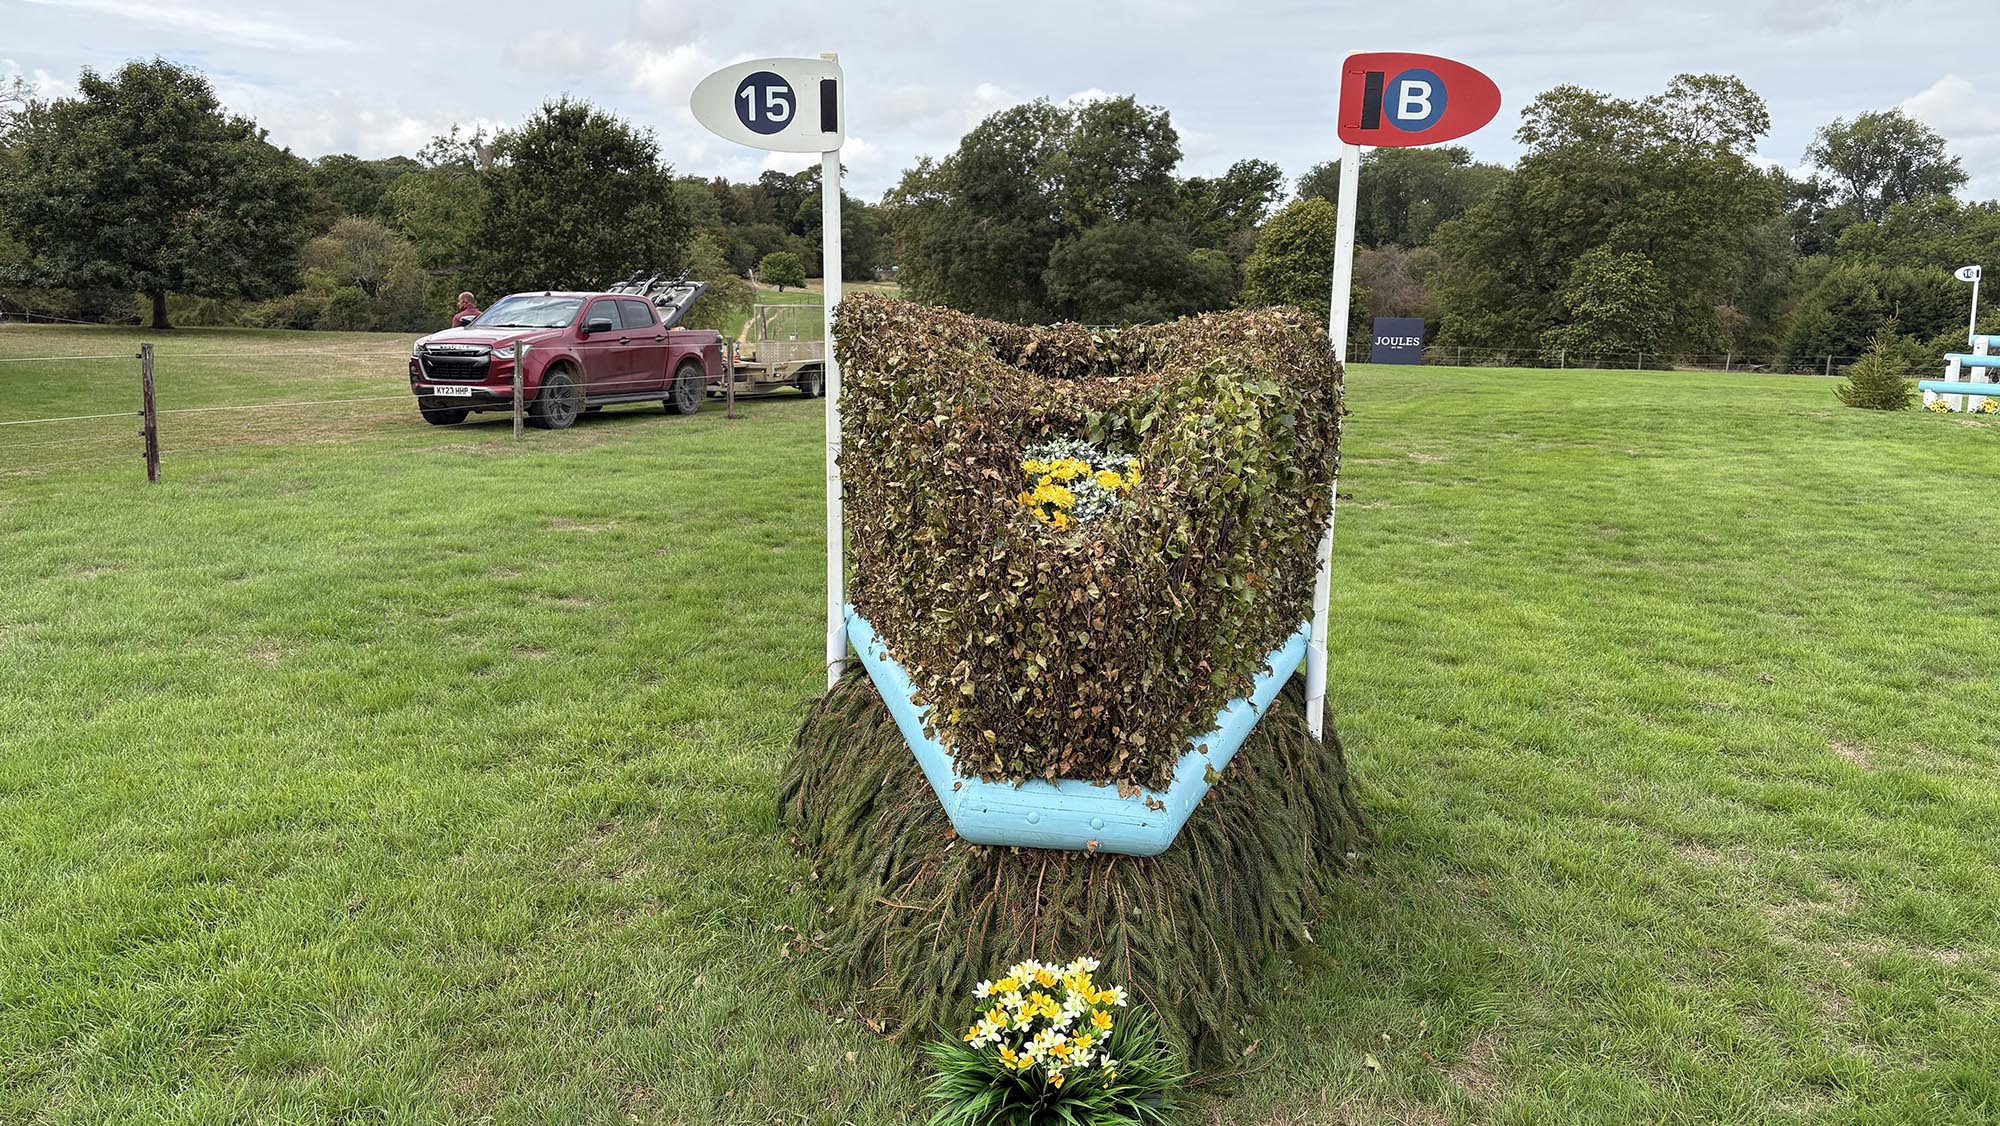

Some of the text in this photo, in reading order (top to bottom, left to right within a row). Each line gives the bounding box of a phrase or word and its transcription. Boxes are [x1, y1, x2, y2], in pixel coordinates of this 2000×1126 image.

[740, 85, 790, 122] 15
[1397, 80, 1432, 120] B
[1963, 269, 1973, 278] 16
[1375, 336, 1420, 346] JOULES
[437, 386, 468, 394] KY23 HHP
